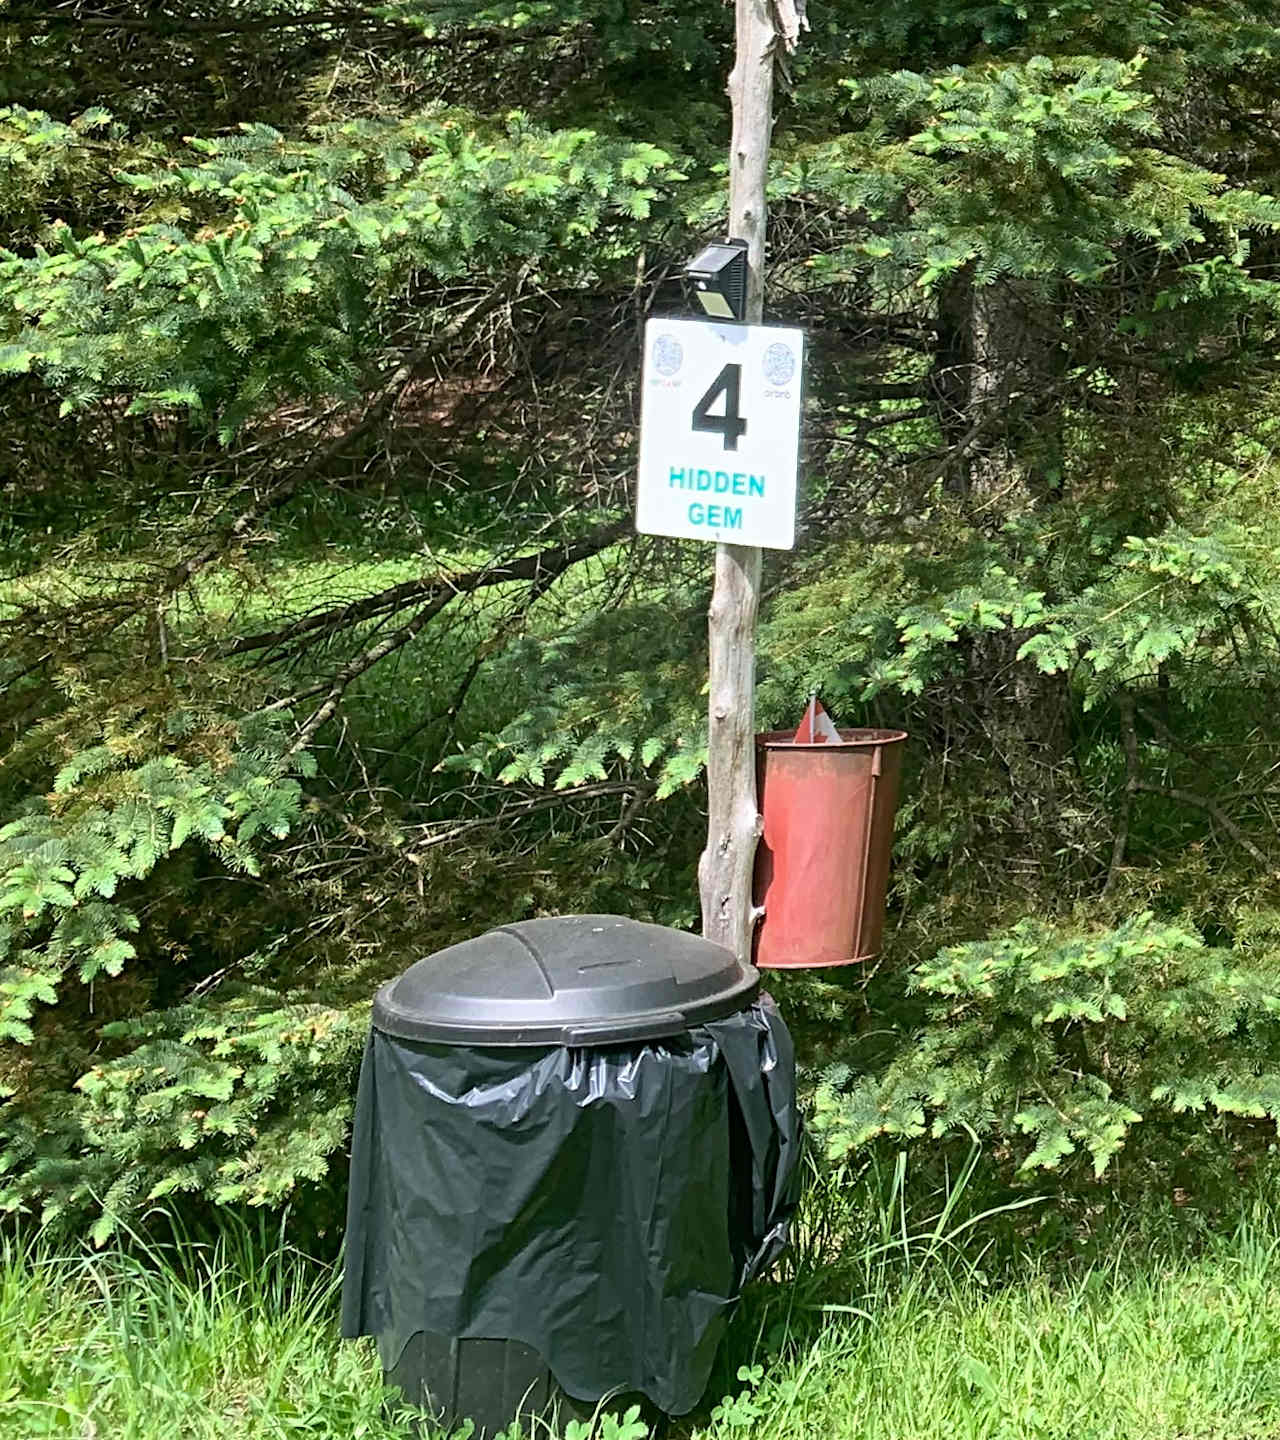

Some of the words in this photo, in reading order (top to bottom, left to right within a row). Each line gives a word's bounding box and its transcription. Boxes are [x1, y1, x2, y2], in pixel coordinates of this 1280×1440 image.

[691, 363, 748, 451] 4
[669, 466, 765, 498] HIDDEN
[688, 502, 742, 529] GEM
